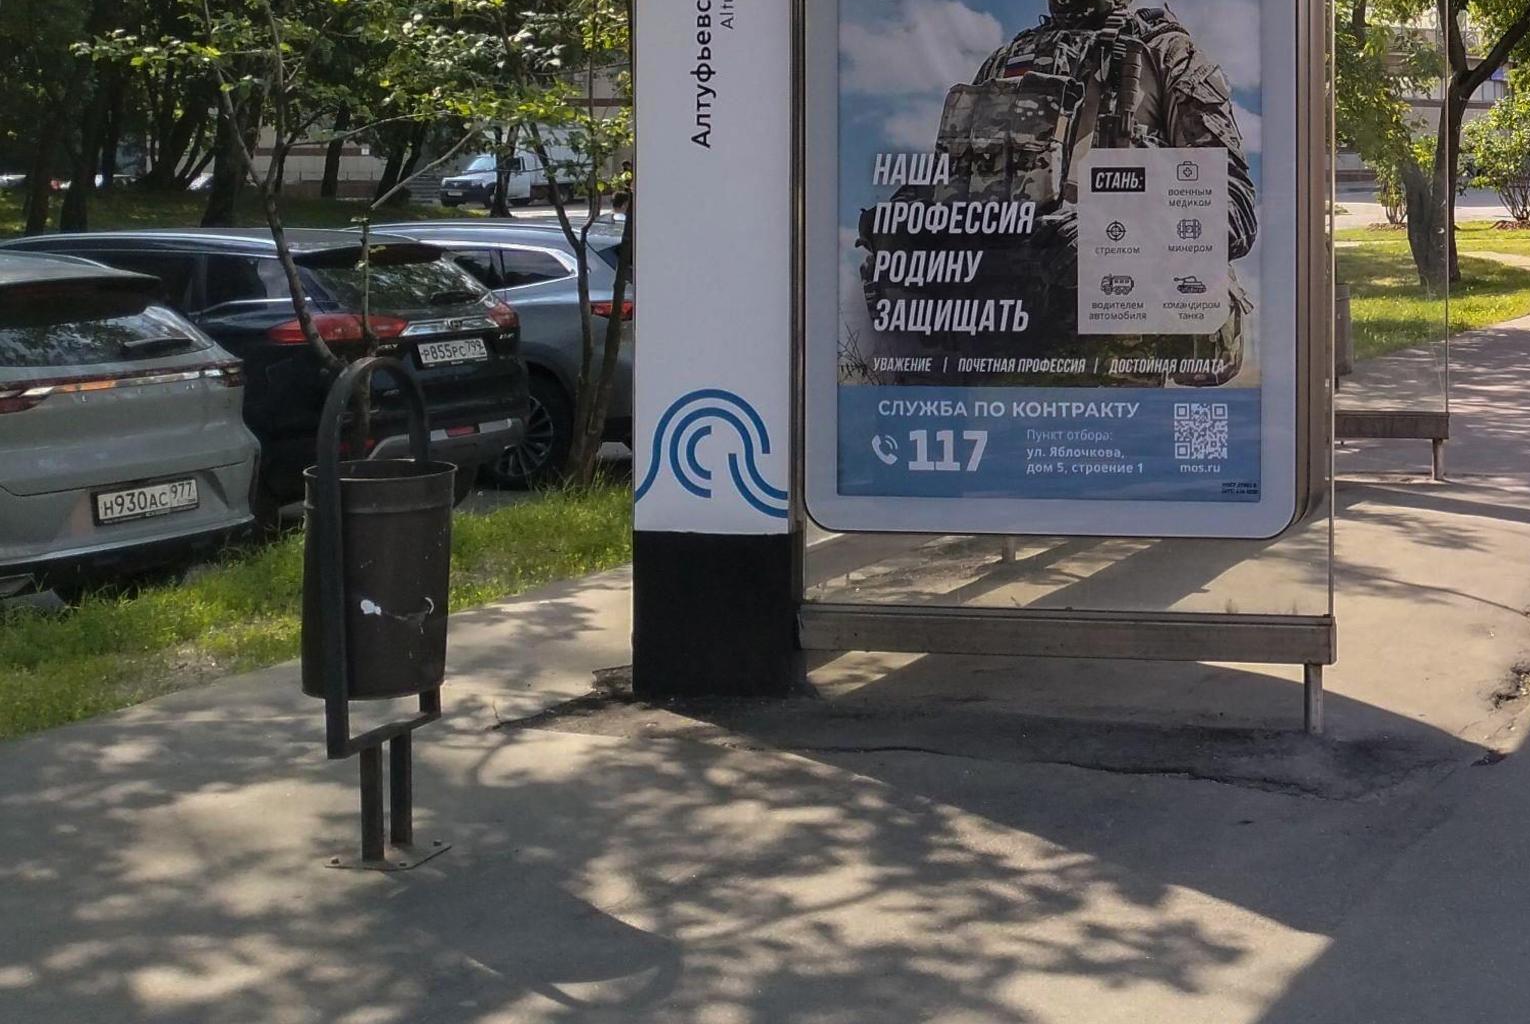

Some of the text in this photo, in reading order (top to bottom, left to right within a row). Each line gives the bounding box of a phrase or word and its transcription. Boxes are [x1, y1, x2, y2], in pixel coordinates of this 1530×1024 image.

[872, 153, 949, 186] НАША
[1095, 172, 1144, 189] СТАНЬ:
[1168, 189, 1212, 197] военным
[1169, 199, 1212, 207] медиком
[872, 201, 1036, 235] ПРОФЕССИЯ
[1095, 246, 1140, 255] стрелком
[1168, 244, 1213, 254] минером
[872, 250, 984, 286] РОДИНУ
[1091, 301, 1144, 310] водителем
[1162, 301, 1221, 310] командиром
[873, 299, 1029, 336] ЗАЩИЩАТЬ
[1088, 310, 1147, 321] автомобиля
[1178, 311, 1205, 320] танка
[873, 357, 932, 372] УВАЖЕНИЕ
[958, 358, 1086, 373] ПОЧЕТНАЯ ПРОФЕССИЯ
[1108, 357, 1224, 374] ДОСТОЙНАЯ ОПЛАТА
[878, 399, 1140, 419] СЛУЖБА ПО КОНТРАКТУ
[1026, 429, 1113, 443] Пункт отбора:
[908, 429, 988, 472] 117
[1026, 447, 1124, 459] ул. Яблочкова,
[1026, 462, 1143, 475] дом 5, строение 1
[1179, 463, 1221, 473] mos.ru
[170, 482, 193, 499] 977
